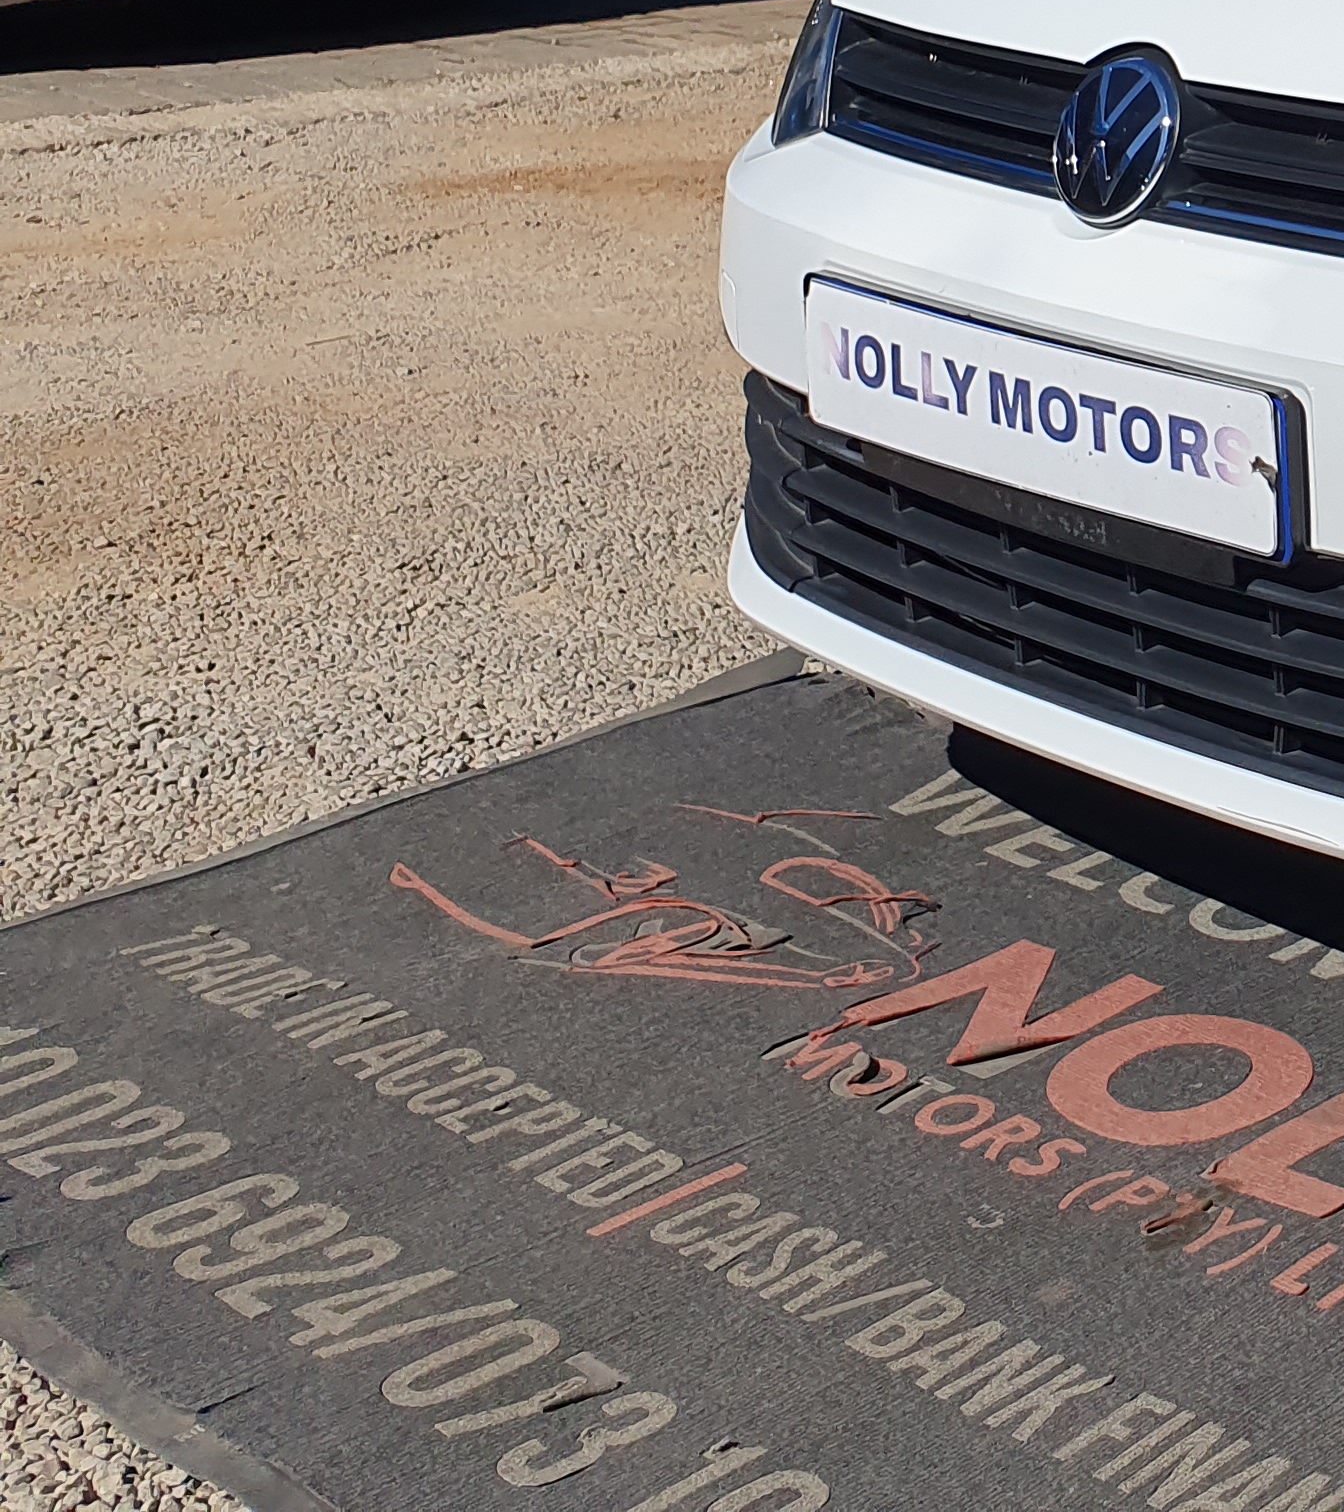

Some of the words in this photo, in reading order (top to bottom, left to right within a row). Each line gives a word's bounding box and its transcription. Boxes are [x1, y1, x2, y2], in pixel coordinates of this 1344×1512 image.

[820, 320, 979, 416] NOLLY
[988, 370, 1256, 488] MOTORS
[118, 924, 349, 1020] TRADE
[271, 992, 410, 1049] IN
